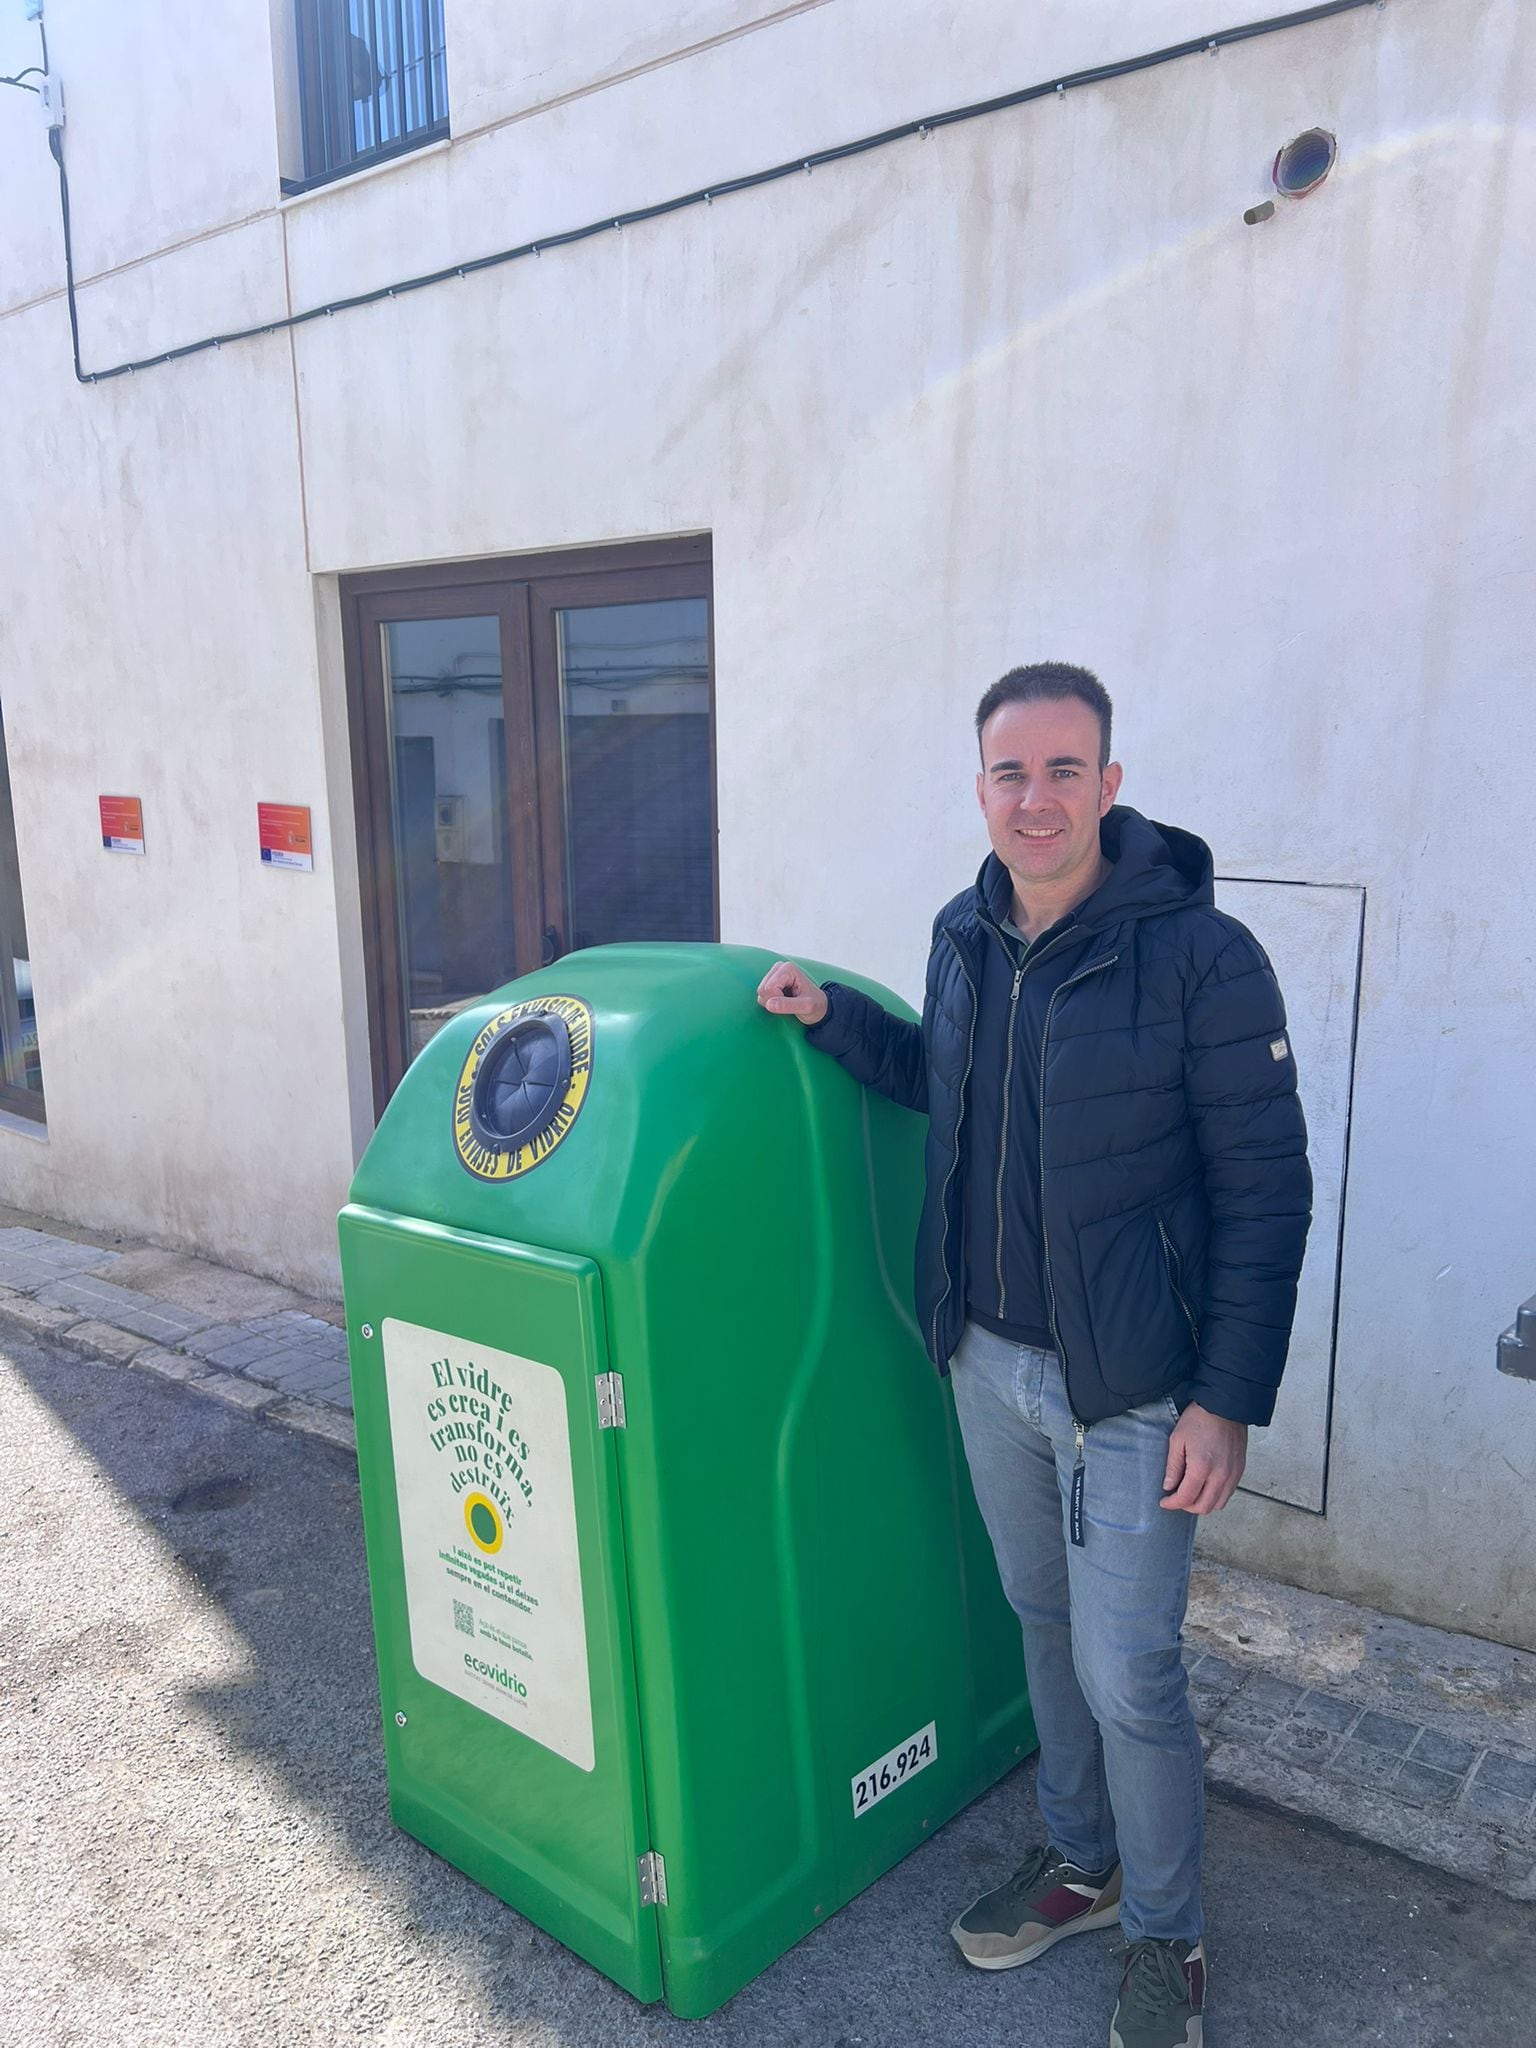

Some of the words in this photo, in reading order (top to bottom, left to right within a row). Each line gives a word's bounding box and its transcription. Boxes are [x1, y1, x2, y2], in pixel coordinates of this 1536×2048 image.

[563, 1007, 585, 1025] DE
[569, 1020, 589, 1076] VIDRE
[457, 1085, 472, 1124] SOLO
[459, 1128, 499, 1176] ENVASES
[529, 1102, 575, 1161] VIDRIO
[506, 1148, 523, 1175] DE
[430, 1358, 455, 1388] El
[456, 1361, 513, 1412] vidre
[427, 1397, 447, 1422] es
[448, 1393, 491, 1424] crea
[495, 1407, 505, 1433] i
[508, 1428, 531, 1461] es
[429, 1419, 533, 1508] transforma,
[454, 1444, 478, 1463] no
[483, 1452, 504, 1480] es
[449, 1466, 515, 1529] destruïx.
[446, 1567, 472, 1585] sempre
[473, 1579, 482, 1590] en
[483, 1584, 491, 1594] el
[492, 1589, 533, 1615] contenidor.
[469, 1566, 498, 1586] vegades
[499, 1580, 506, 1590] si
[507, 1584, 514, 1594] el
[515, 1588, 539, 1607] deixes
[473, 1557, 482, 1567] es
[483, 1561, 496, 1574] pot
[497, 1568, 523, 1586] repetir
[464, 1653, 528, 1698] ecovidrio
[856, 1735, 931, 1809] 216.924
